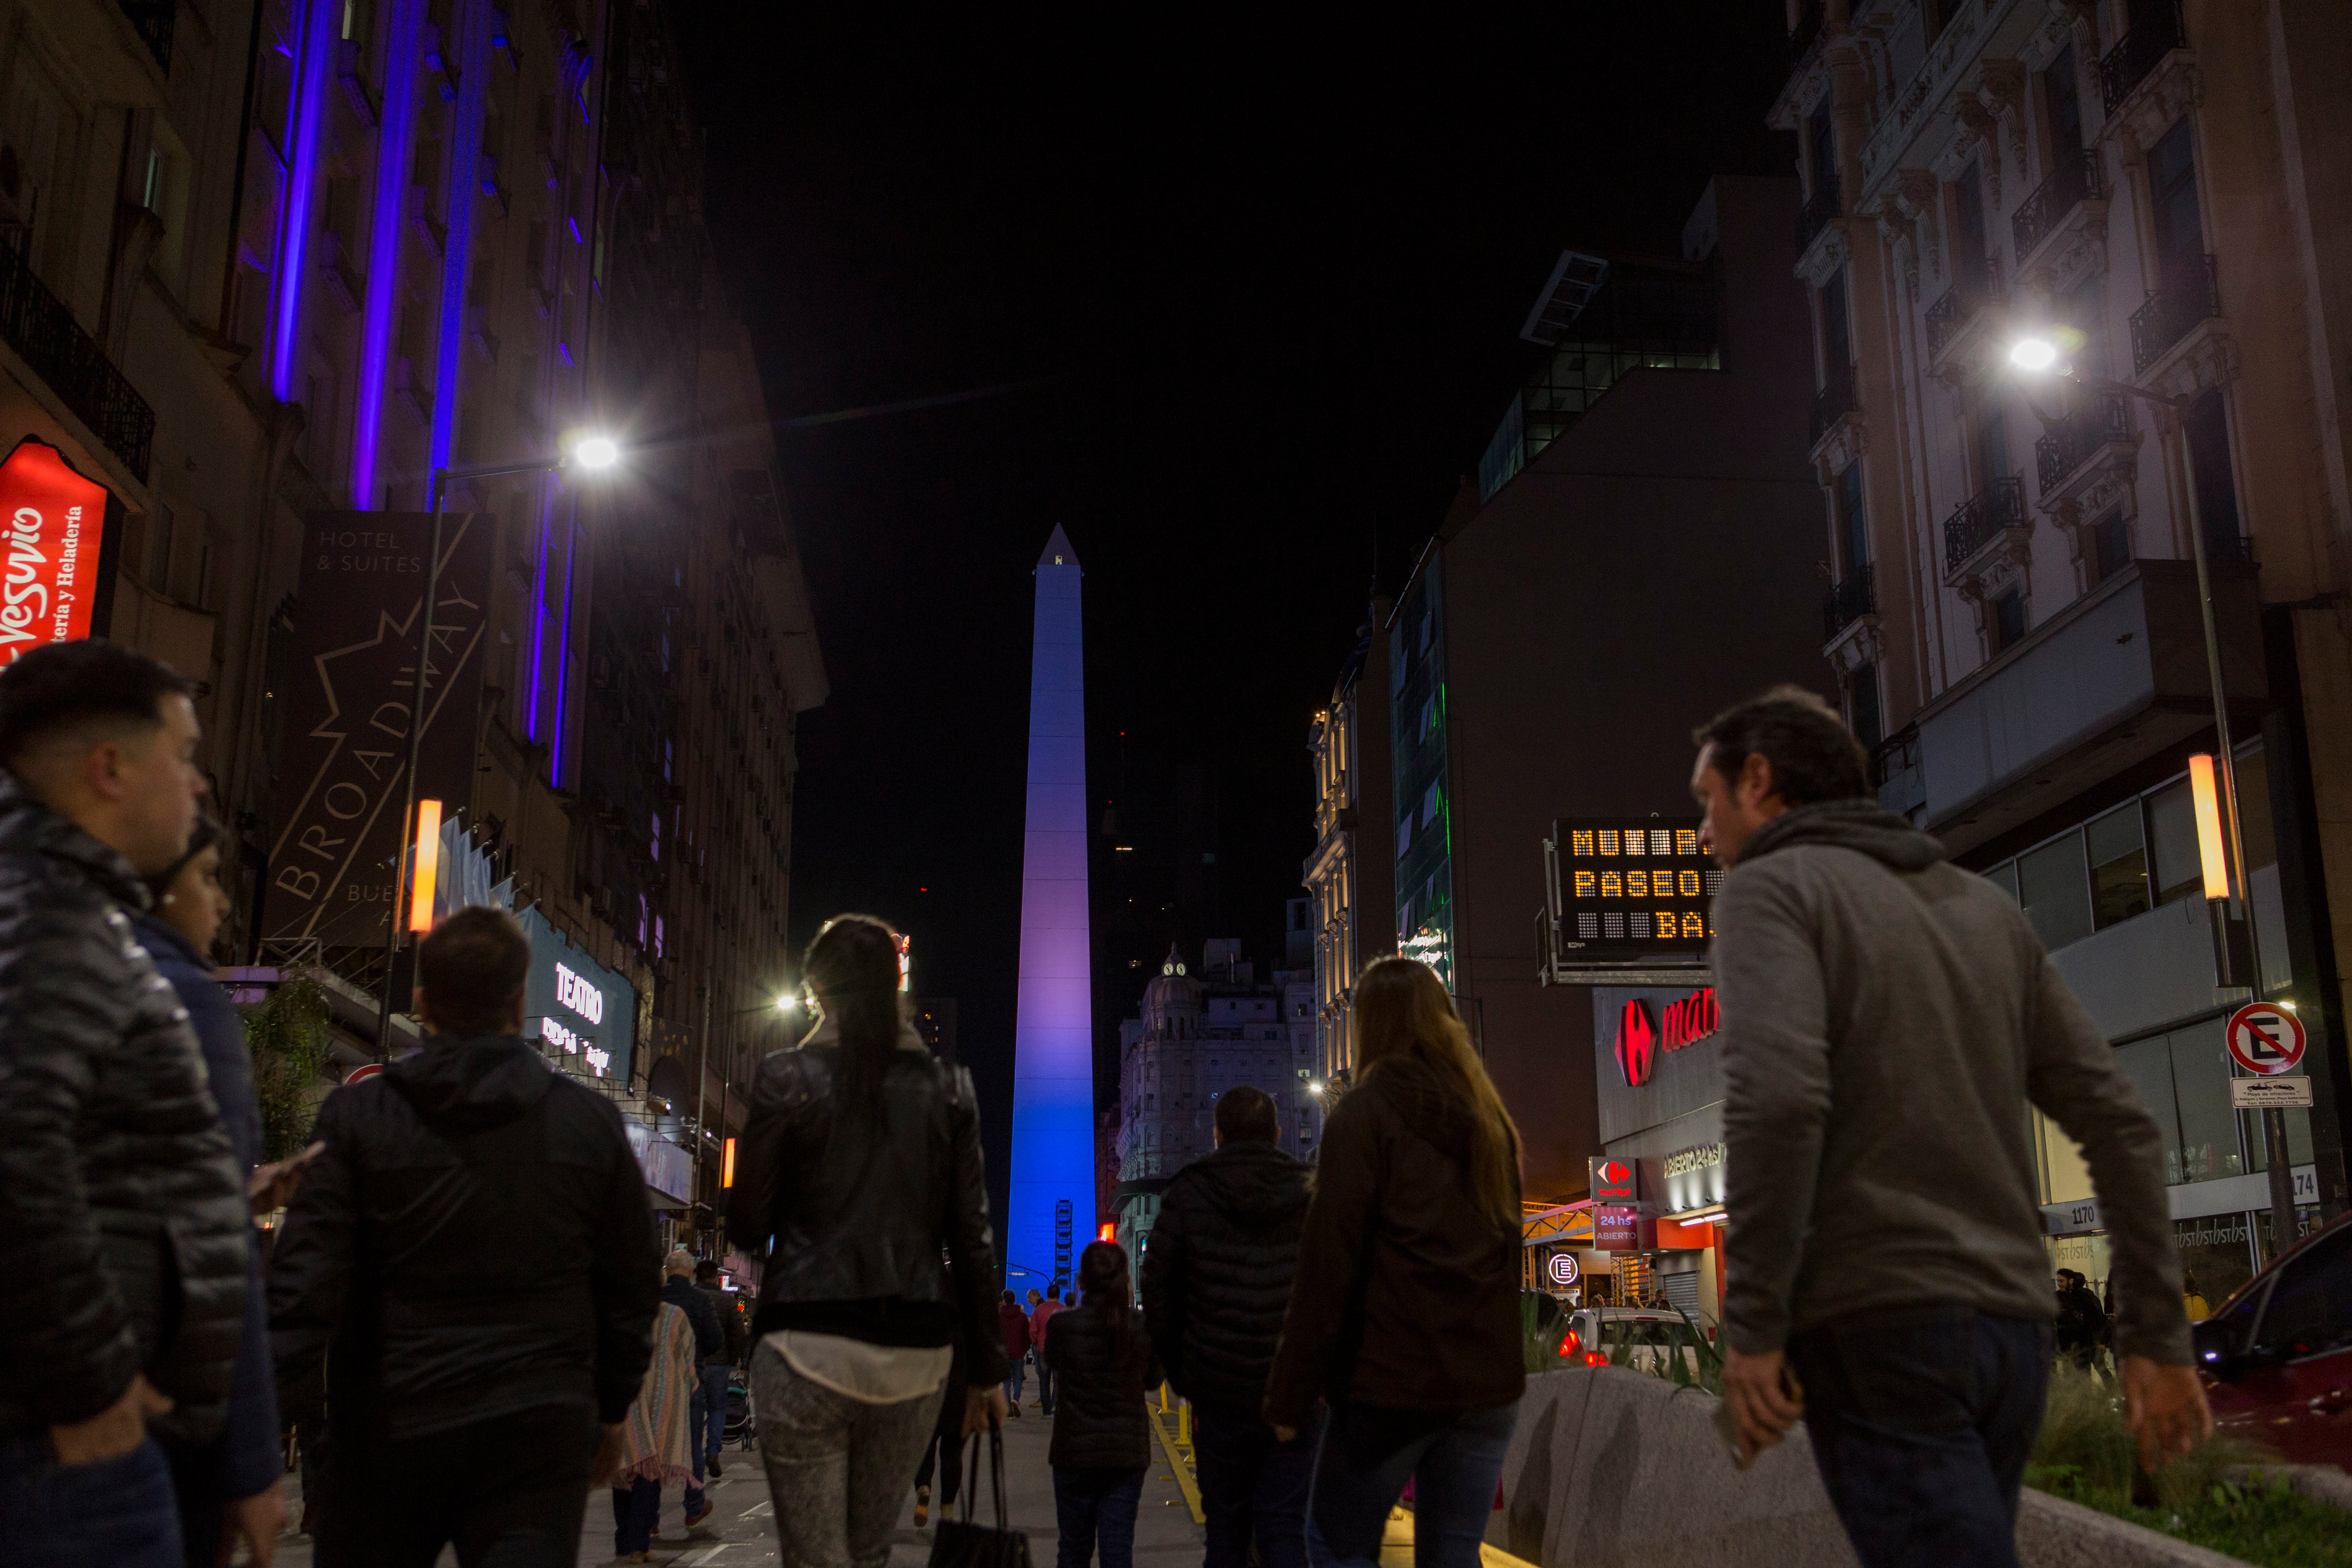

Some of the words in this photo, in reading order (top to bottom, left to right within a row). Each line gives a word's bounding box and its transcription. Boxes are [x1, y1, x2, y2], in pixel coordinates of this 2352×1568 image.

[56, 506, 82, 587] Heladería
[320, 531, 399, 549] HOTEL
[317, 555, 330, 570] &
[341, 555, 421, 572] SUITES
[0, 507, 48, 644] Vesuvio
[58, 590, 75, 601] y
[275, 581, 479, 901] BROADWAY
[1574, 870, 1700, 897] PASEO
[1655, 911, 1717, 938] BA
[556, 962, 603, 1025] TEATRO
[1664, 1151, 1696, 1179] ABIERTO
[1696, 1147, 1708, 1169] 24
[1598, 1188, 1631, 1197] market
[1600, 1215, 1616, 1226] 24
[1617, 1215, 1632, 1226] hs
[2072, 1206, 2094, 1225] 1170
[1597, 1232, 1637, 1240] ABIERTO
[1555, 1258, 1572, 1279] E
